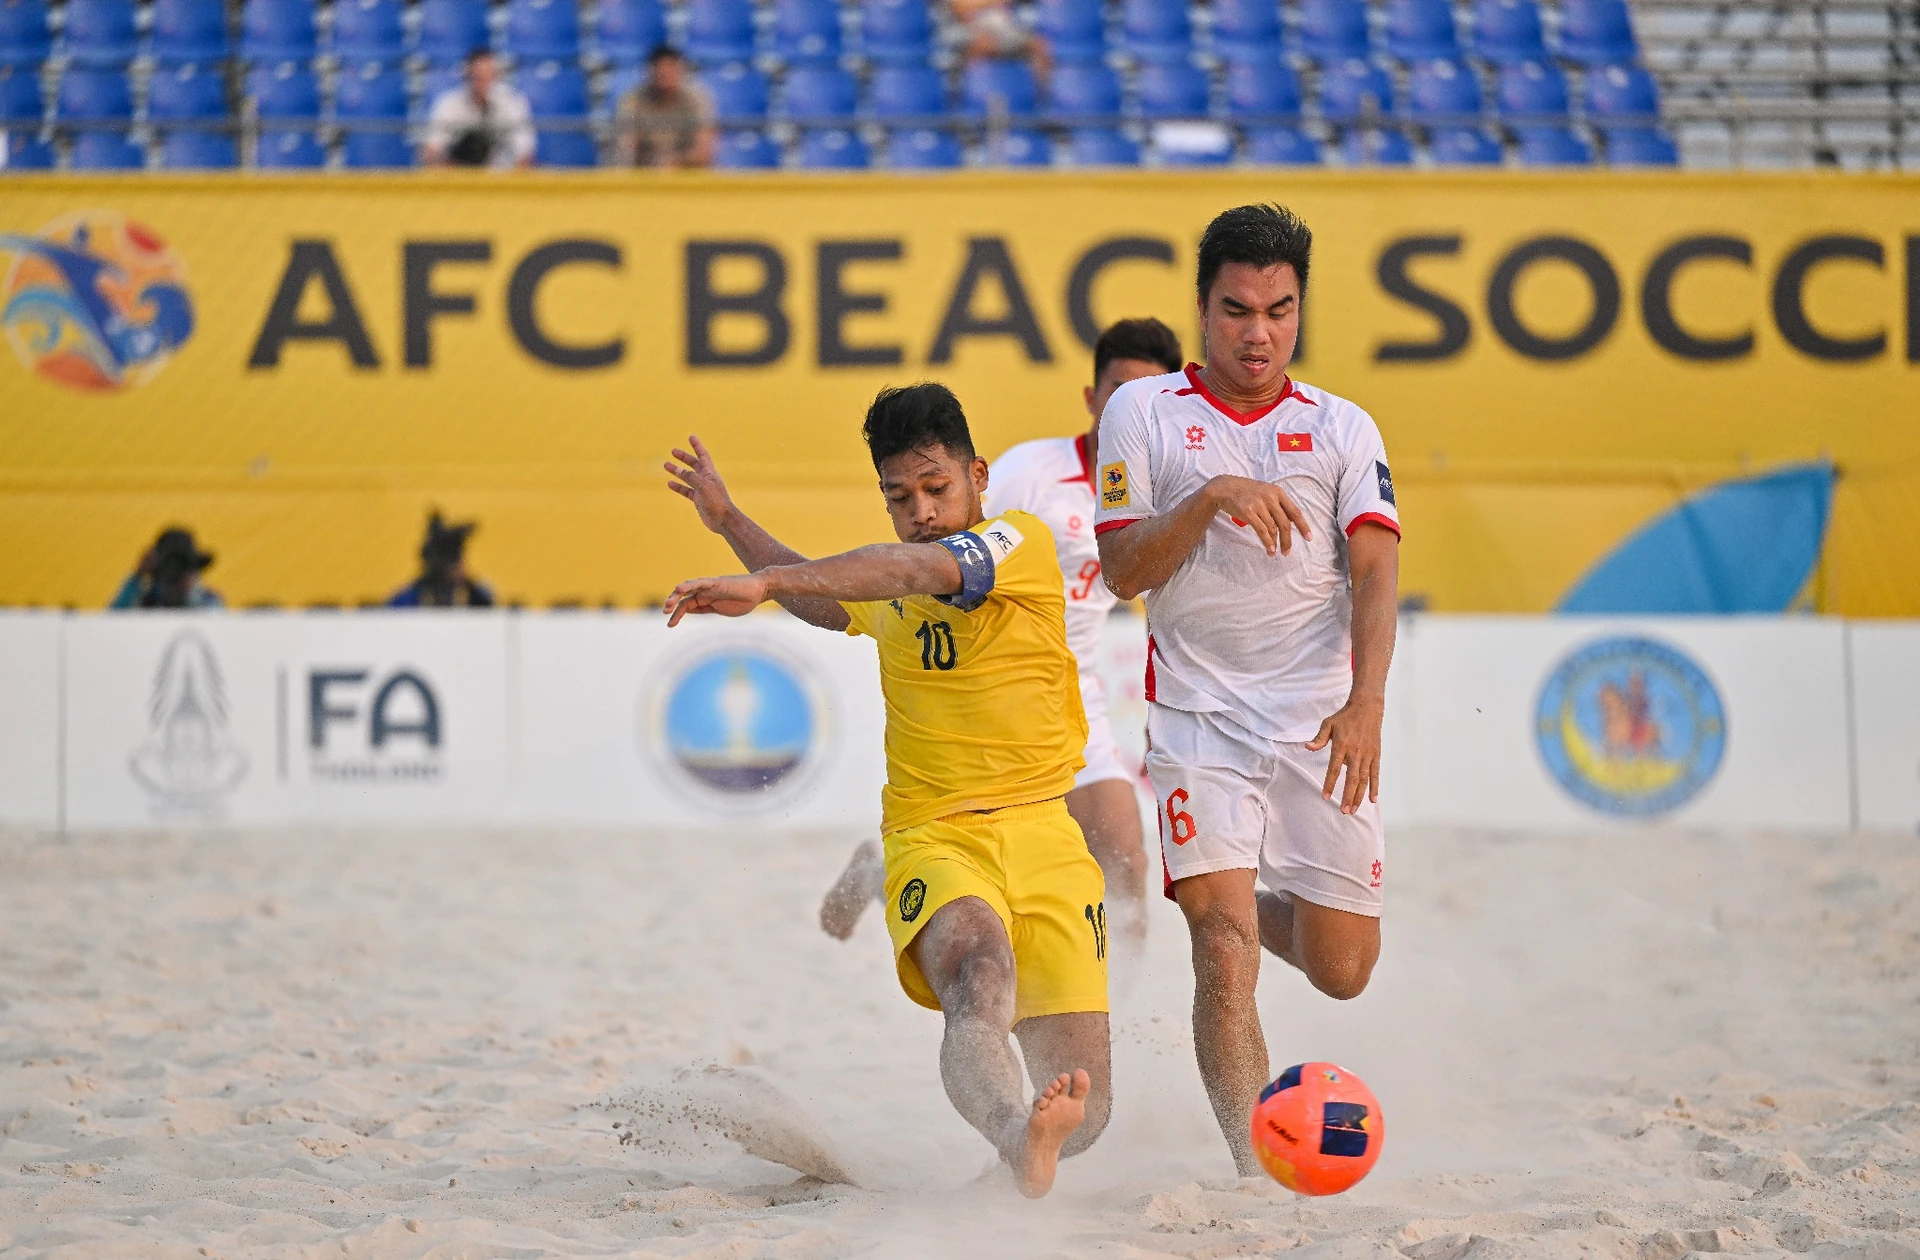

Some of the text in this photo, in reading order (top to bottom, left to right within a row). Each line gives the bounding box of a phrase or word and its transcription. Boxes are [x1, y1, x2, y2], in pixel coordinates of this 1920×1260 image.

[247, 233, 1920, 370] AFC BEAC SOCC
[986, 531, 1014, 550] AFC
[1070, 559, 1100, 600] 9
[915, 620, 958, 670] 10
[308, 670, 442, 748] FA
[1166, 787, 1197, 846] 6
